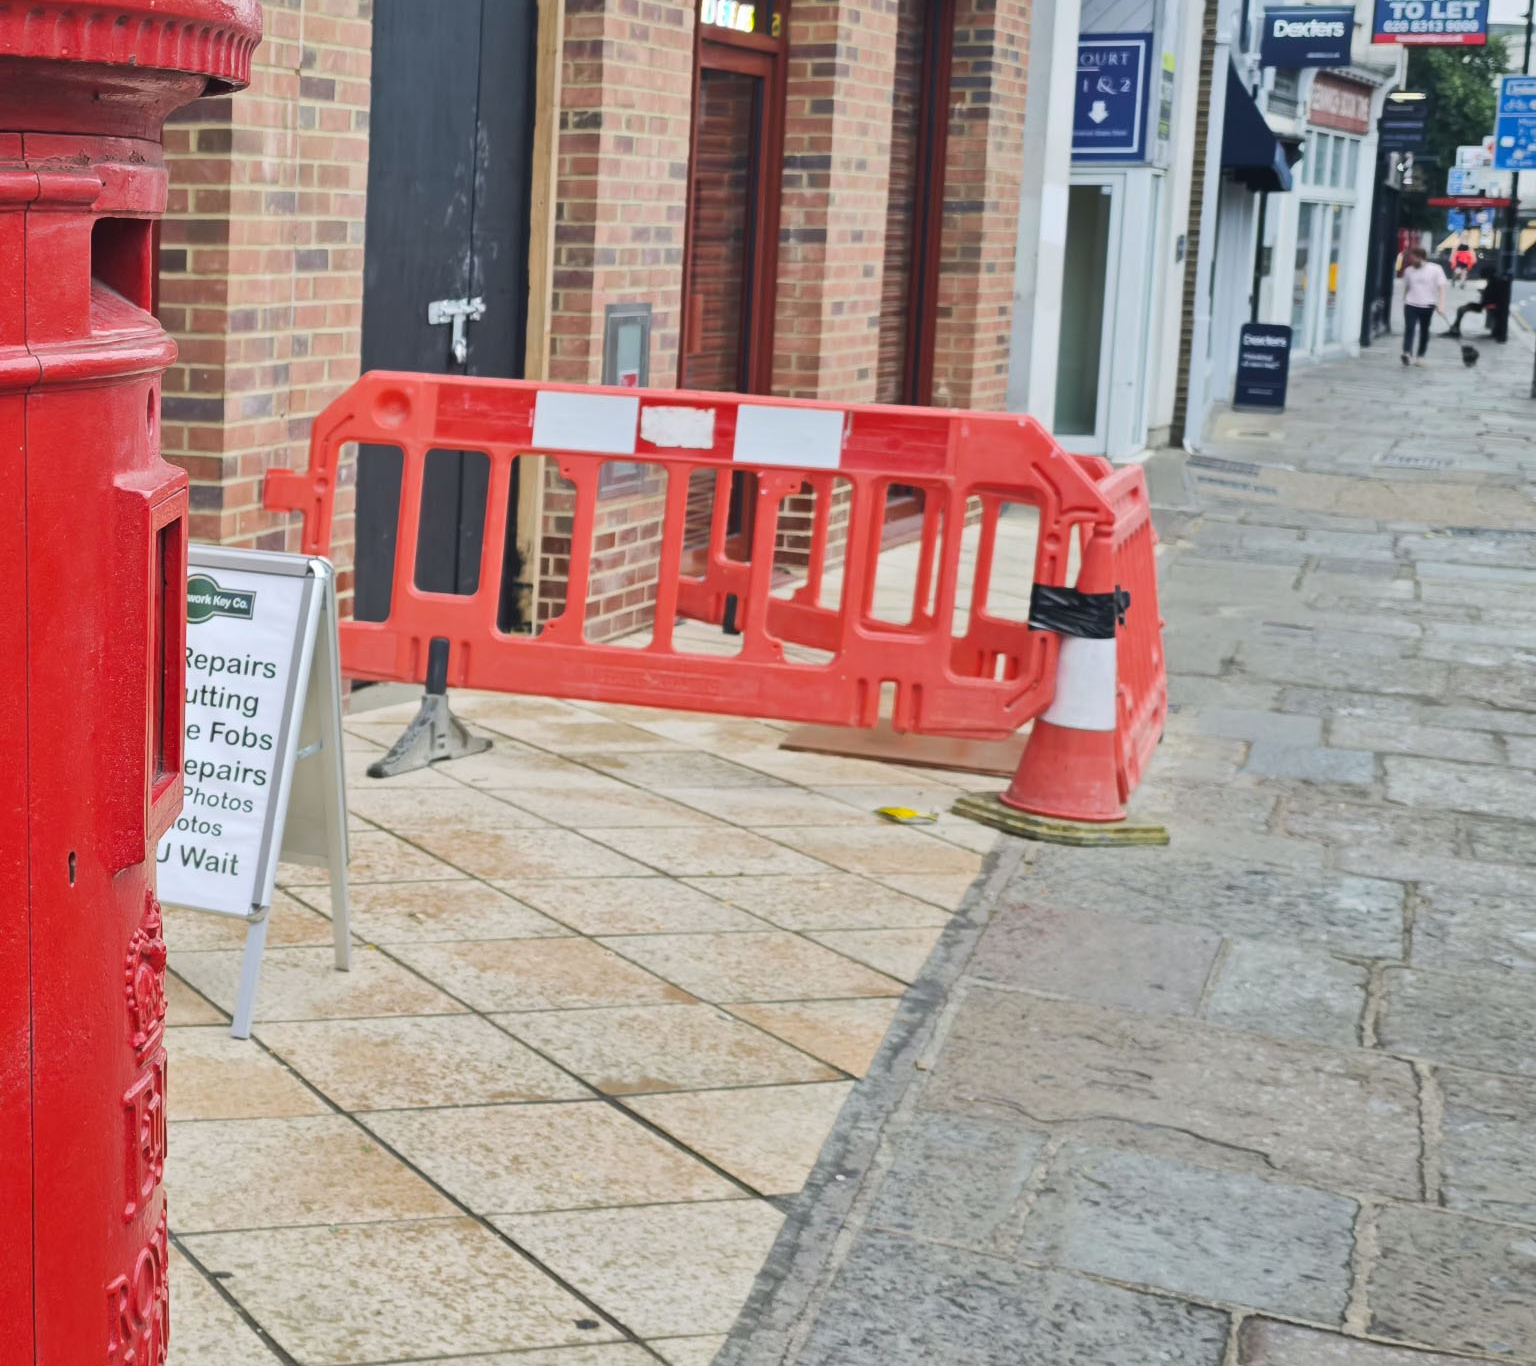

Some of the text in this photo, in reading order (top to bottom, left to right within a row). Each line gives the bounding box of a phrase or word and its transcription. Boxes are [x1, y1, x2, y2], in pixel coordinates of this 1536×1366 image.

[1389, 1, 1480, 19] TO LET
[1273, 19, 1344, 37] Dexters
[1120, 77, 1131, 92] 2
[213, 595, 231, 609] Key
[233, 597, 248, 609] Co.
[186, 647, 276, 678] Repairs
[210, 722, 273, 750] Fobs
[184, 759, 267, 786] epairs
[184, 786, 254, 813] Photos
[171, 815, 223, 836] otos
[180, 845, 238, 876] Wait
